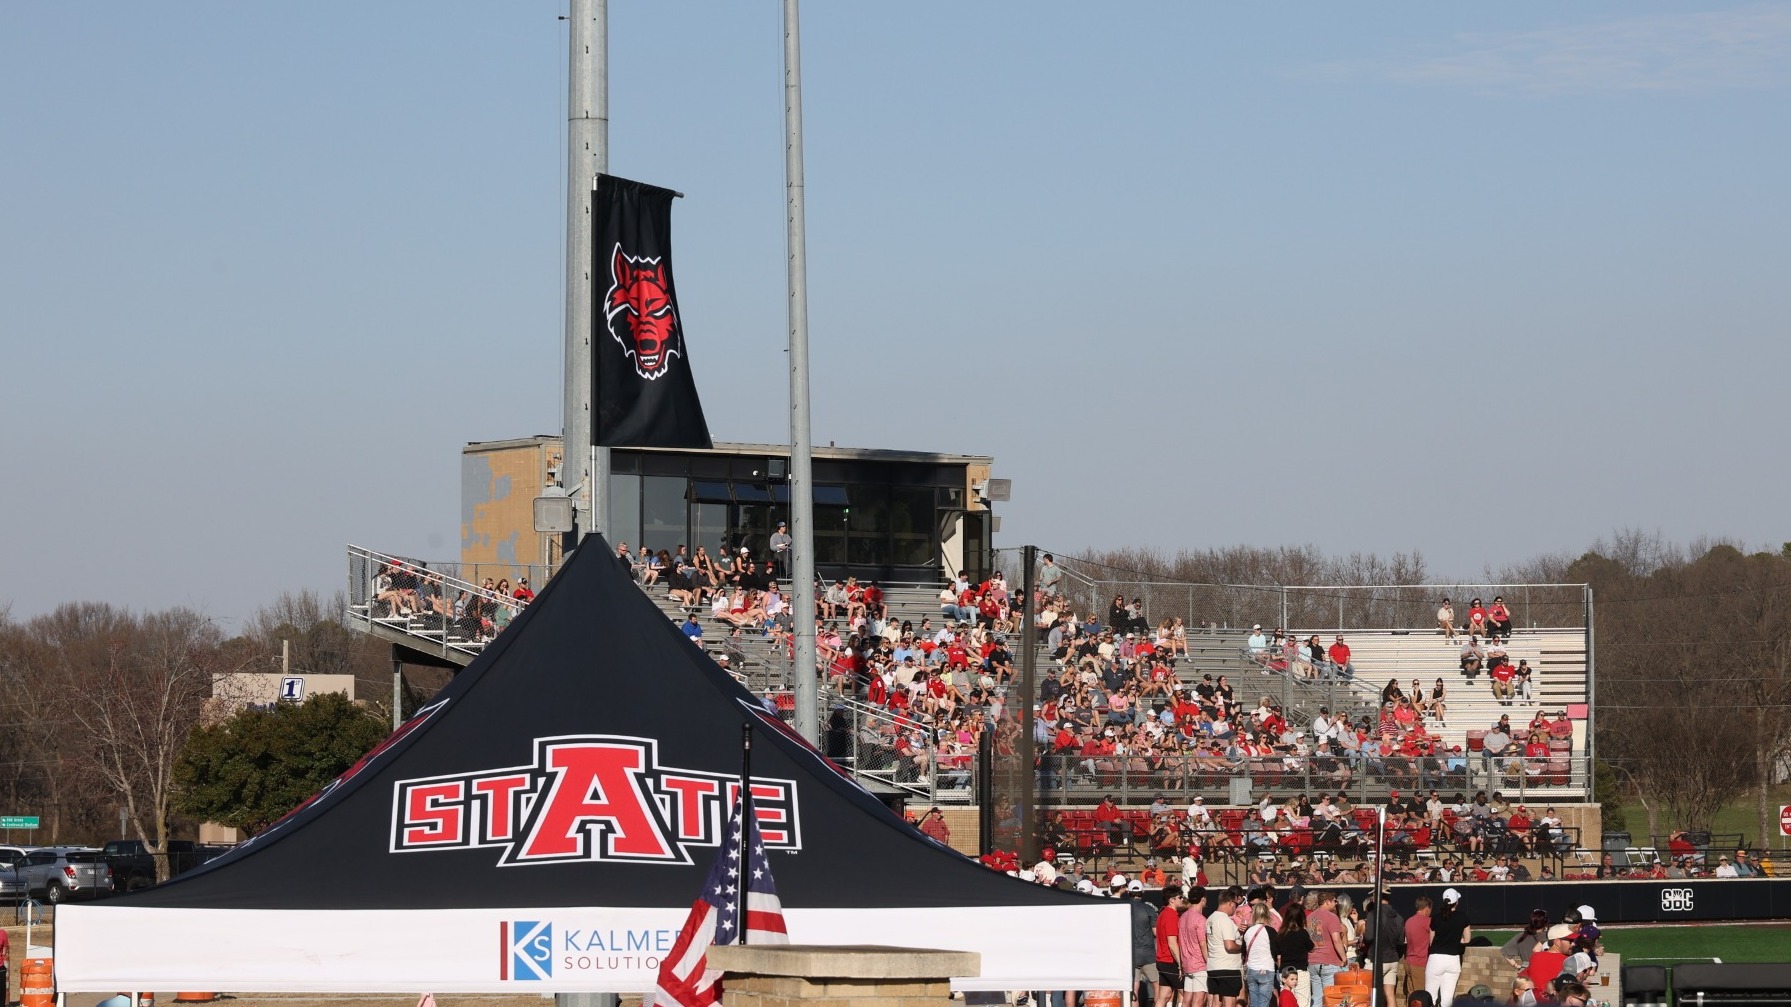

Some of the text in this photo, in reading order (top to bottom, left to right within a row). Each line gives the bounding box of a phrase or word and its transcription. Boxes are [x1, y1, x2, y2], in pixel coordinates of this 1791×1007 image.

[392, 737, 799, 866] STATE
[1661, 888, 1694, 911] SBC
[564, 956, 659, 969] SOLUTIO
